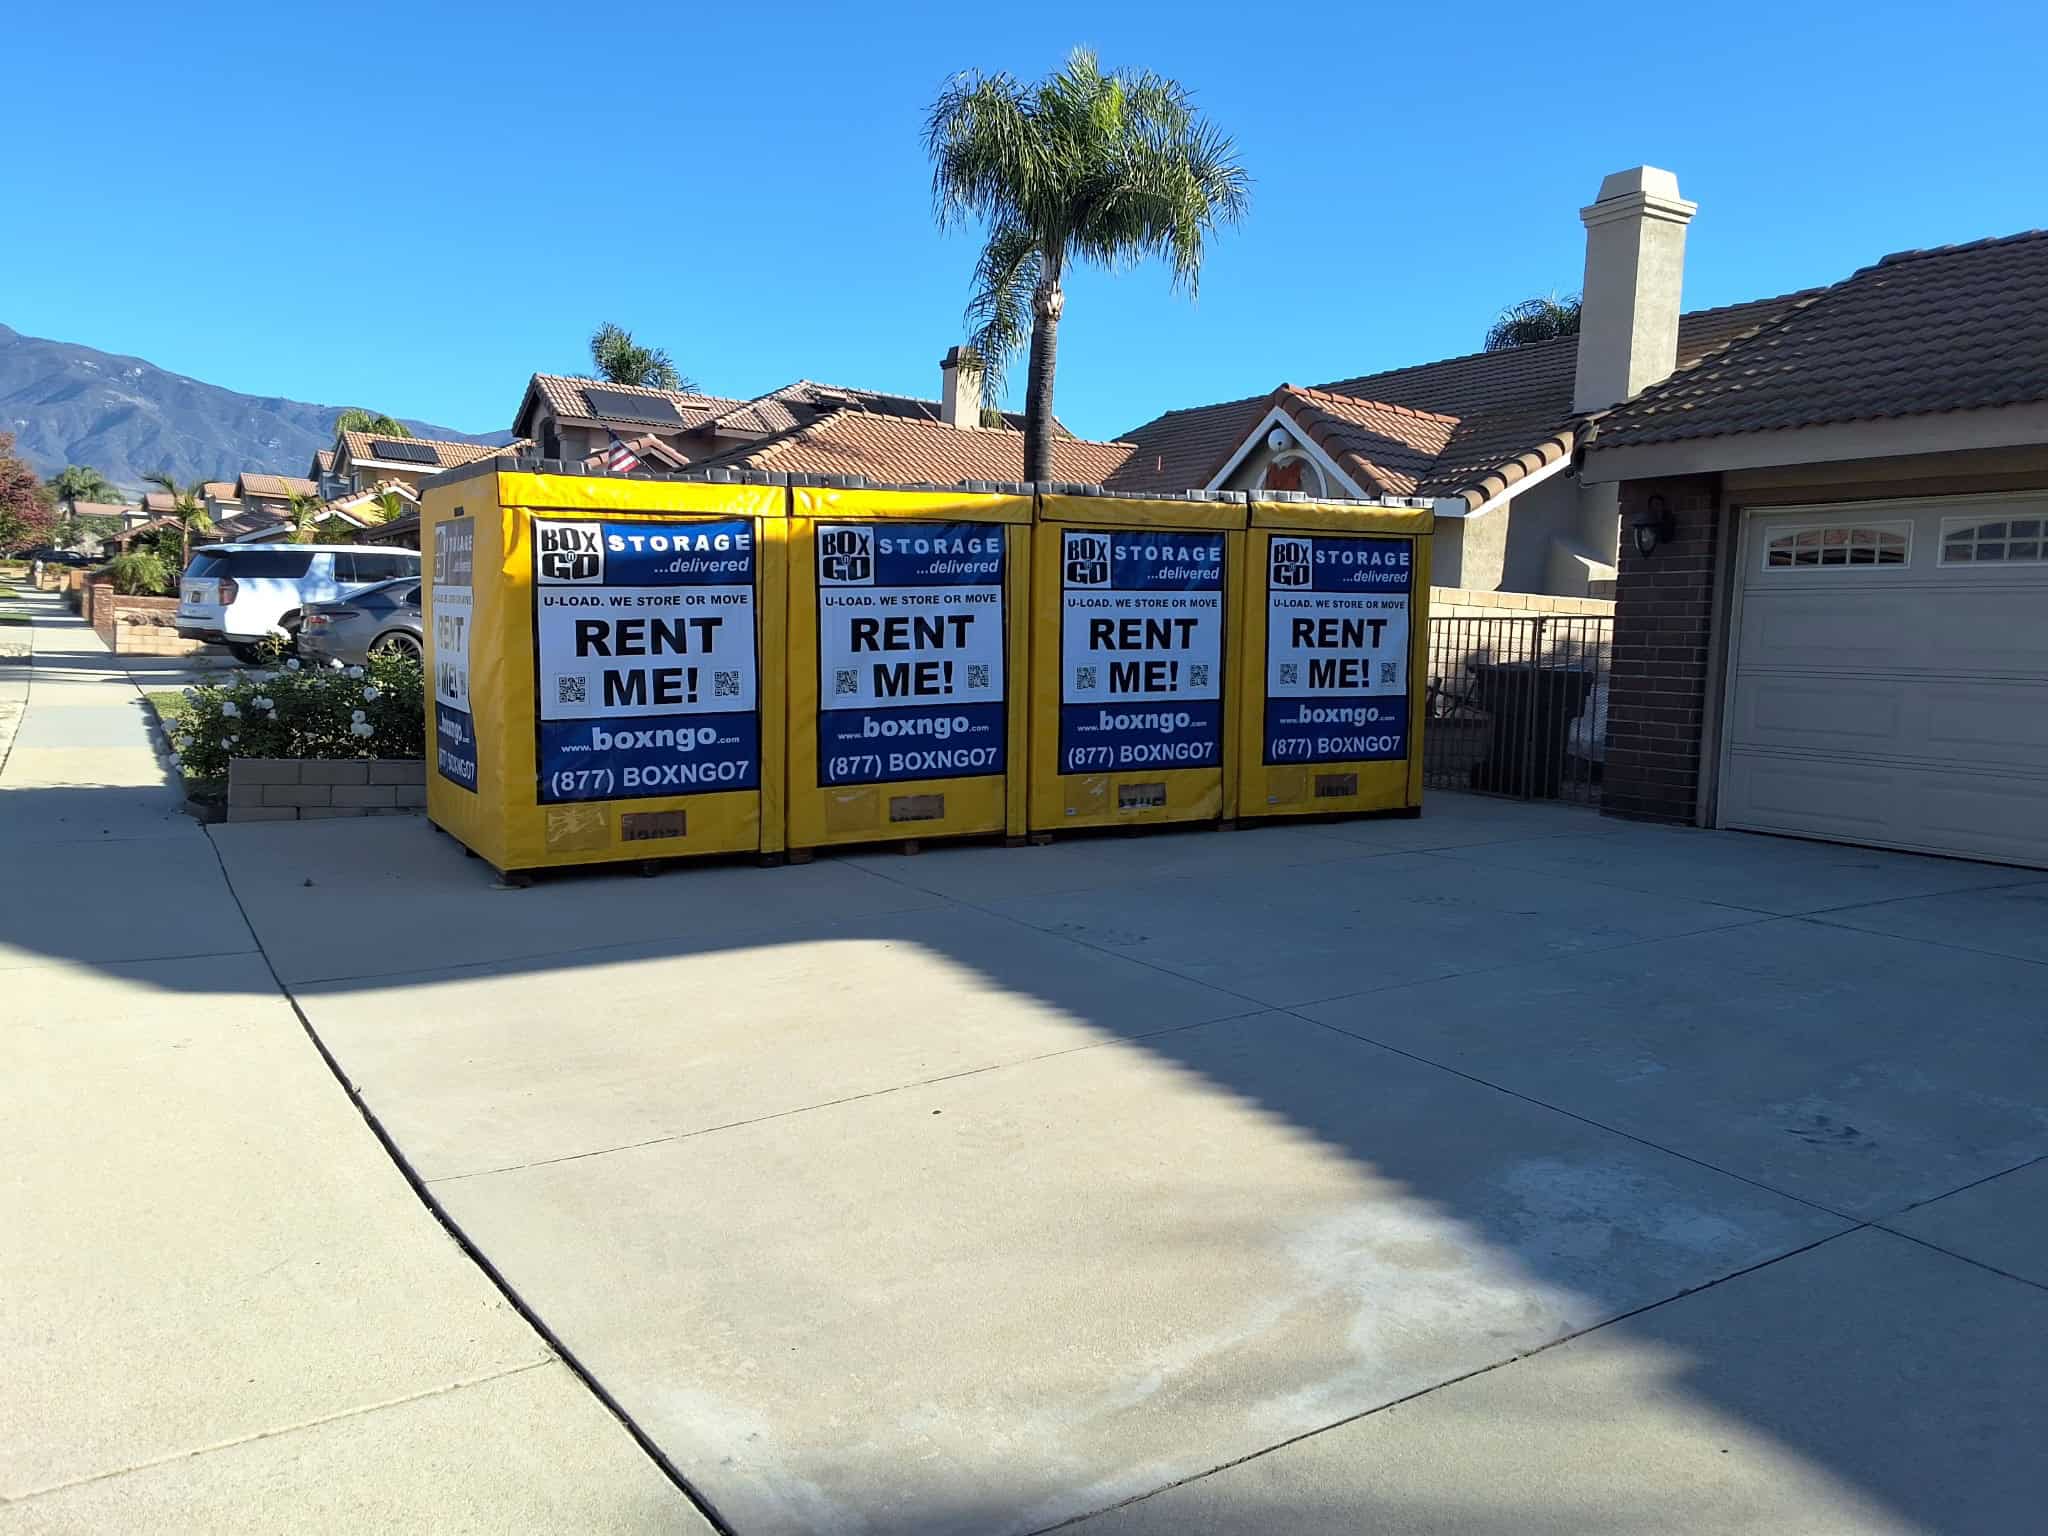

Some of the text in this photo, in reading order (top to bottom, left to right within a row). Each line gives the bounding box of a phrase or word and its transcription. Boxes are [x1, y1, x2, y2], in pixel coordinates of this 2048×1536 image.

[541, 527, 598, 552] BOX
[608, 534, 750, 552] STORAGE
[822, 530, 870, 556] BOX
[879, 538, 999, 555] STORAGE
[1067, 538, 1108, 561] BOX
[1115, 545, 1221, 561] STORAGE
[1273, 542, 1309, 564] BOX
[1315, 550, 1409, 566] STORAGE
[542, 553, 599, 580] GO
[823, 556, 870, 581] GO
[1067, 561, 1108, 584] GO
[1273, 564, 1310, 586] GO
[544, 594, 748, 607] U-LOAD. WE STORE OR MOVE
[825, 593, 997, 607] U-LOAD. WE STORE OR MOVE
[1068, 598, 1218, 608] U-LOAD. WE STORE OR MOVE
[1274, 599, 1405, 609] U-LOAD. WE STORE OR MOVE
[575, 617, 723, 657] RENT
[851, 615, 974, 652] RENT
[1090, 618, 1199, 650] RENT
[1292, 618, 1387, 648] RENT
[873, 660, 953, 698] ME!
[1110, 661, 1178, 693] ME!
[1309, 658, 1370, 689] ME!
[603, 667, 698, 707] ME!
[1068, 741, 1214, 769] (877) BOXNGO7
[1272, 735, 1400, 760] (877) BOXNGO7
[829, 747, 997, 780] (877) BOXNGO7
[551, 761, 750, 797] (877) BOXNGO7
